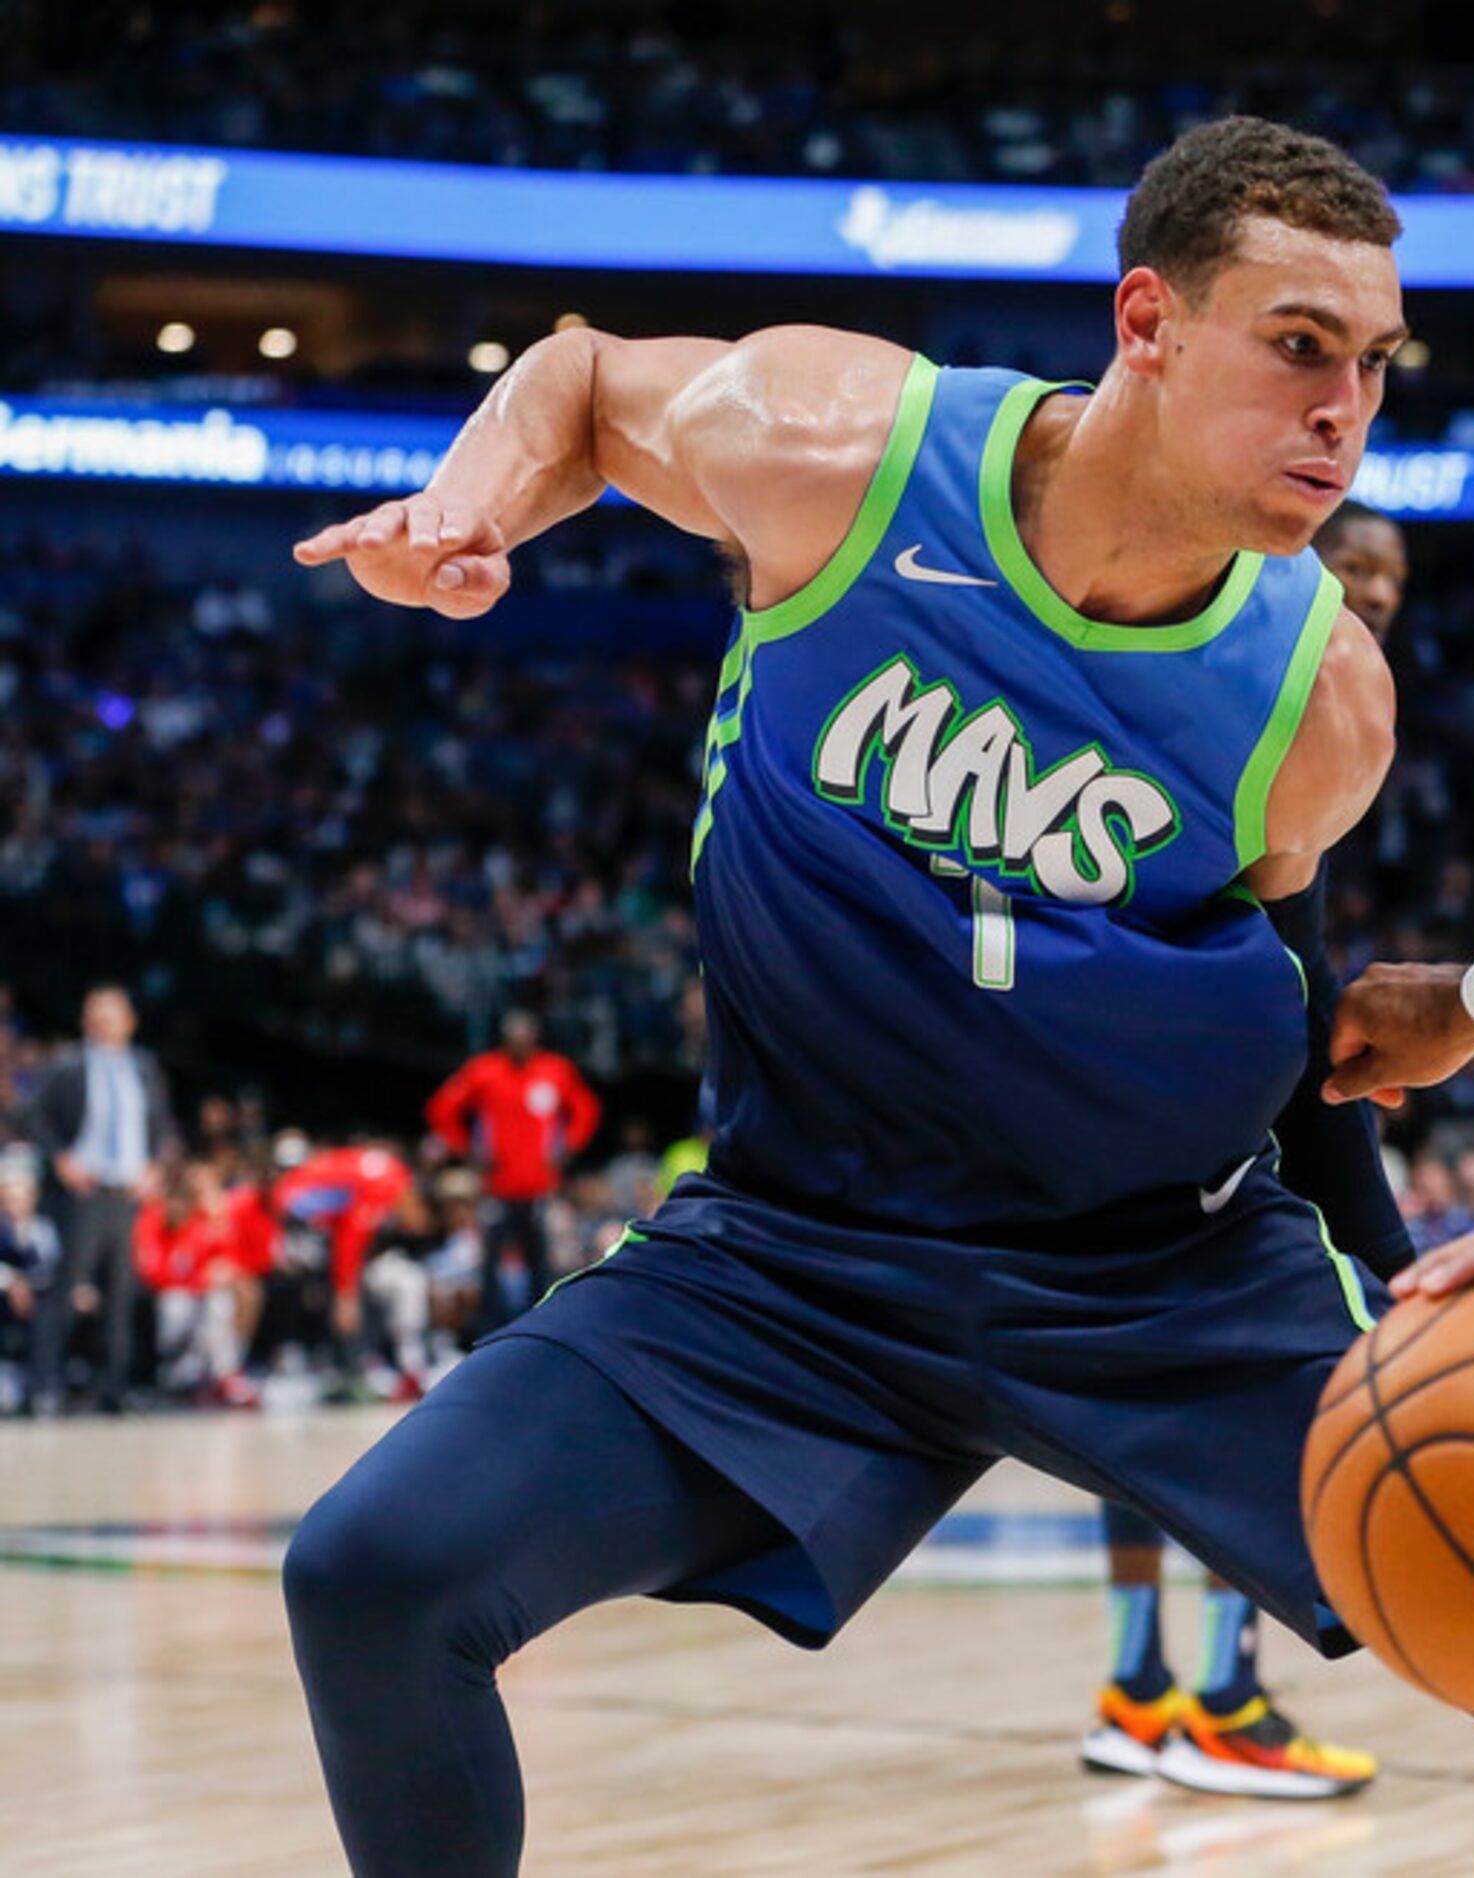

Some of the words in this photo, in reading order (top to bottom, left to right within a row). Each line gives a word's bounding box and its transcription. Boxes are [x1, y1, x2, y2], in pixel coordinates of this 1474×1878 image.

[64, 147, 229, 234] TRUST
[0, 402, 268, 483] ermania
[812, 650, 1183, 908] MAVS
[930, 853, 1016, 993] 1
